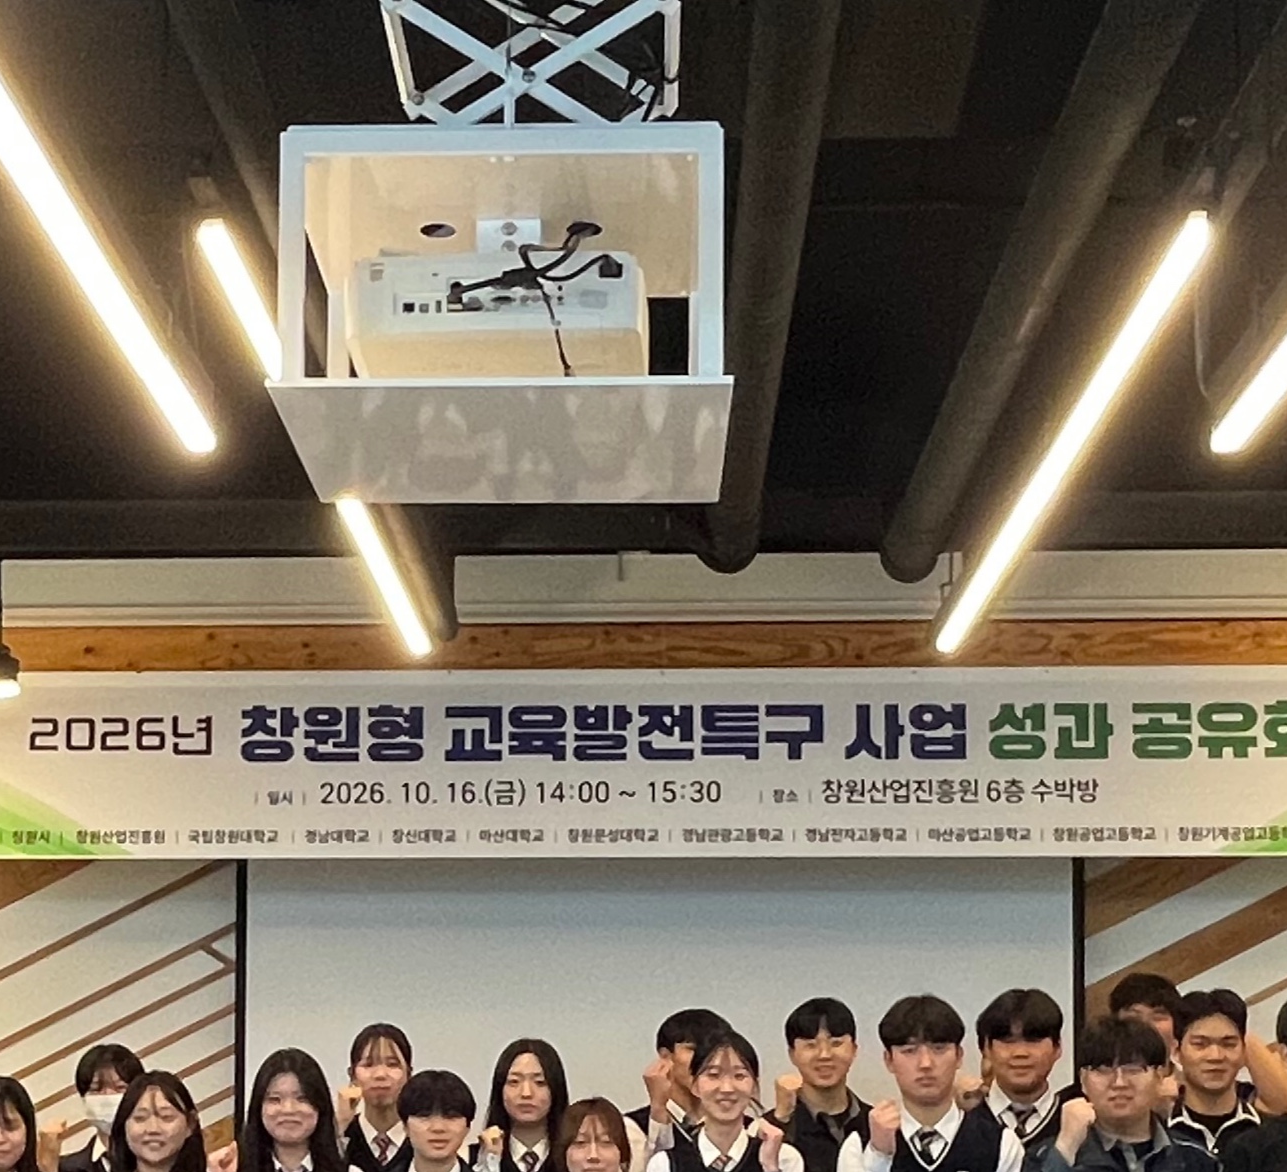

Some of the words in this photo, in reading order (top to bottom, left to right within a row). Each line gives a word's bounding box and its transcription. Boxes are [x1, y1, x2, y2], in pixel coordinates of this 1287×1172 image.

[27, 714, 213, 757] 2026년
[239, 703, 424, 763] 창원형
[444, 702, 825, 762] 교육발전특구
[844, 701, 968, 760] 사업
[987, 701, 1114, 760] 성과
[319, 781, 393, 805] 2026.
[401, 781, 439, 805] 10.
[535, 781, 610, 804] 14:00
[647, 780, 722, 804] 15:30
[821, 778, 980, 804] 창원산업진흥원
[986, 778, 1026, 804] 6층
[1030, 778, 1099, 803] 수박방
[76, 828, 166, 845] 창원산업진흥원
[188, 828, 280, 844] 국립창원대학교
[304, 828, 370, 845] 경남대학교
[391, 828, 457, 844] 창신대학교
[478, 828, 545, 844] 마산대학교
[567, 827, 660, 844] 창원문성대학교
